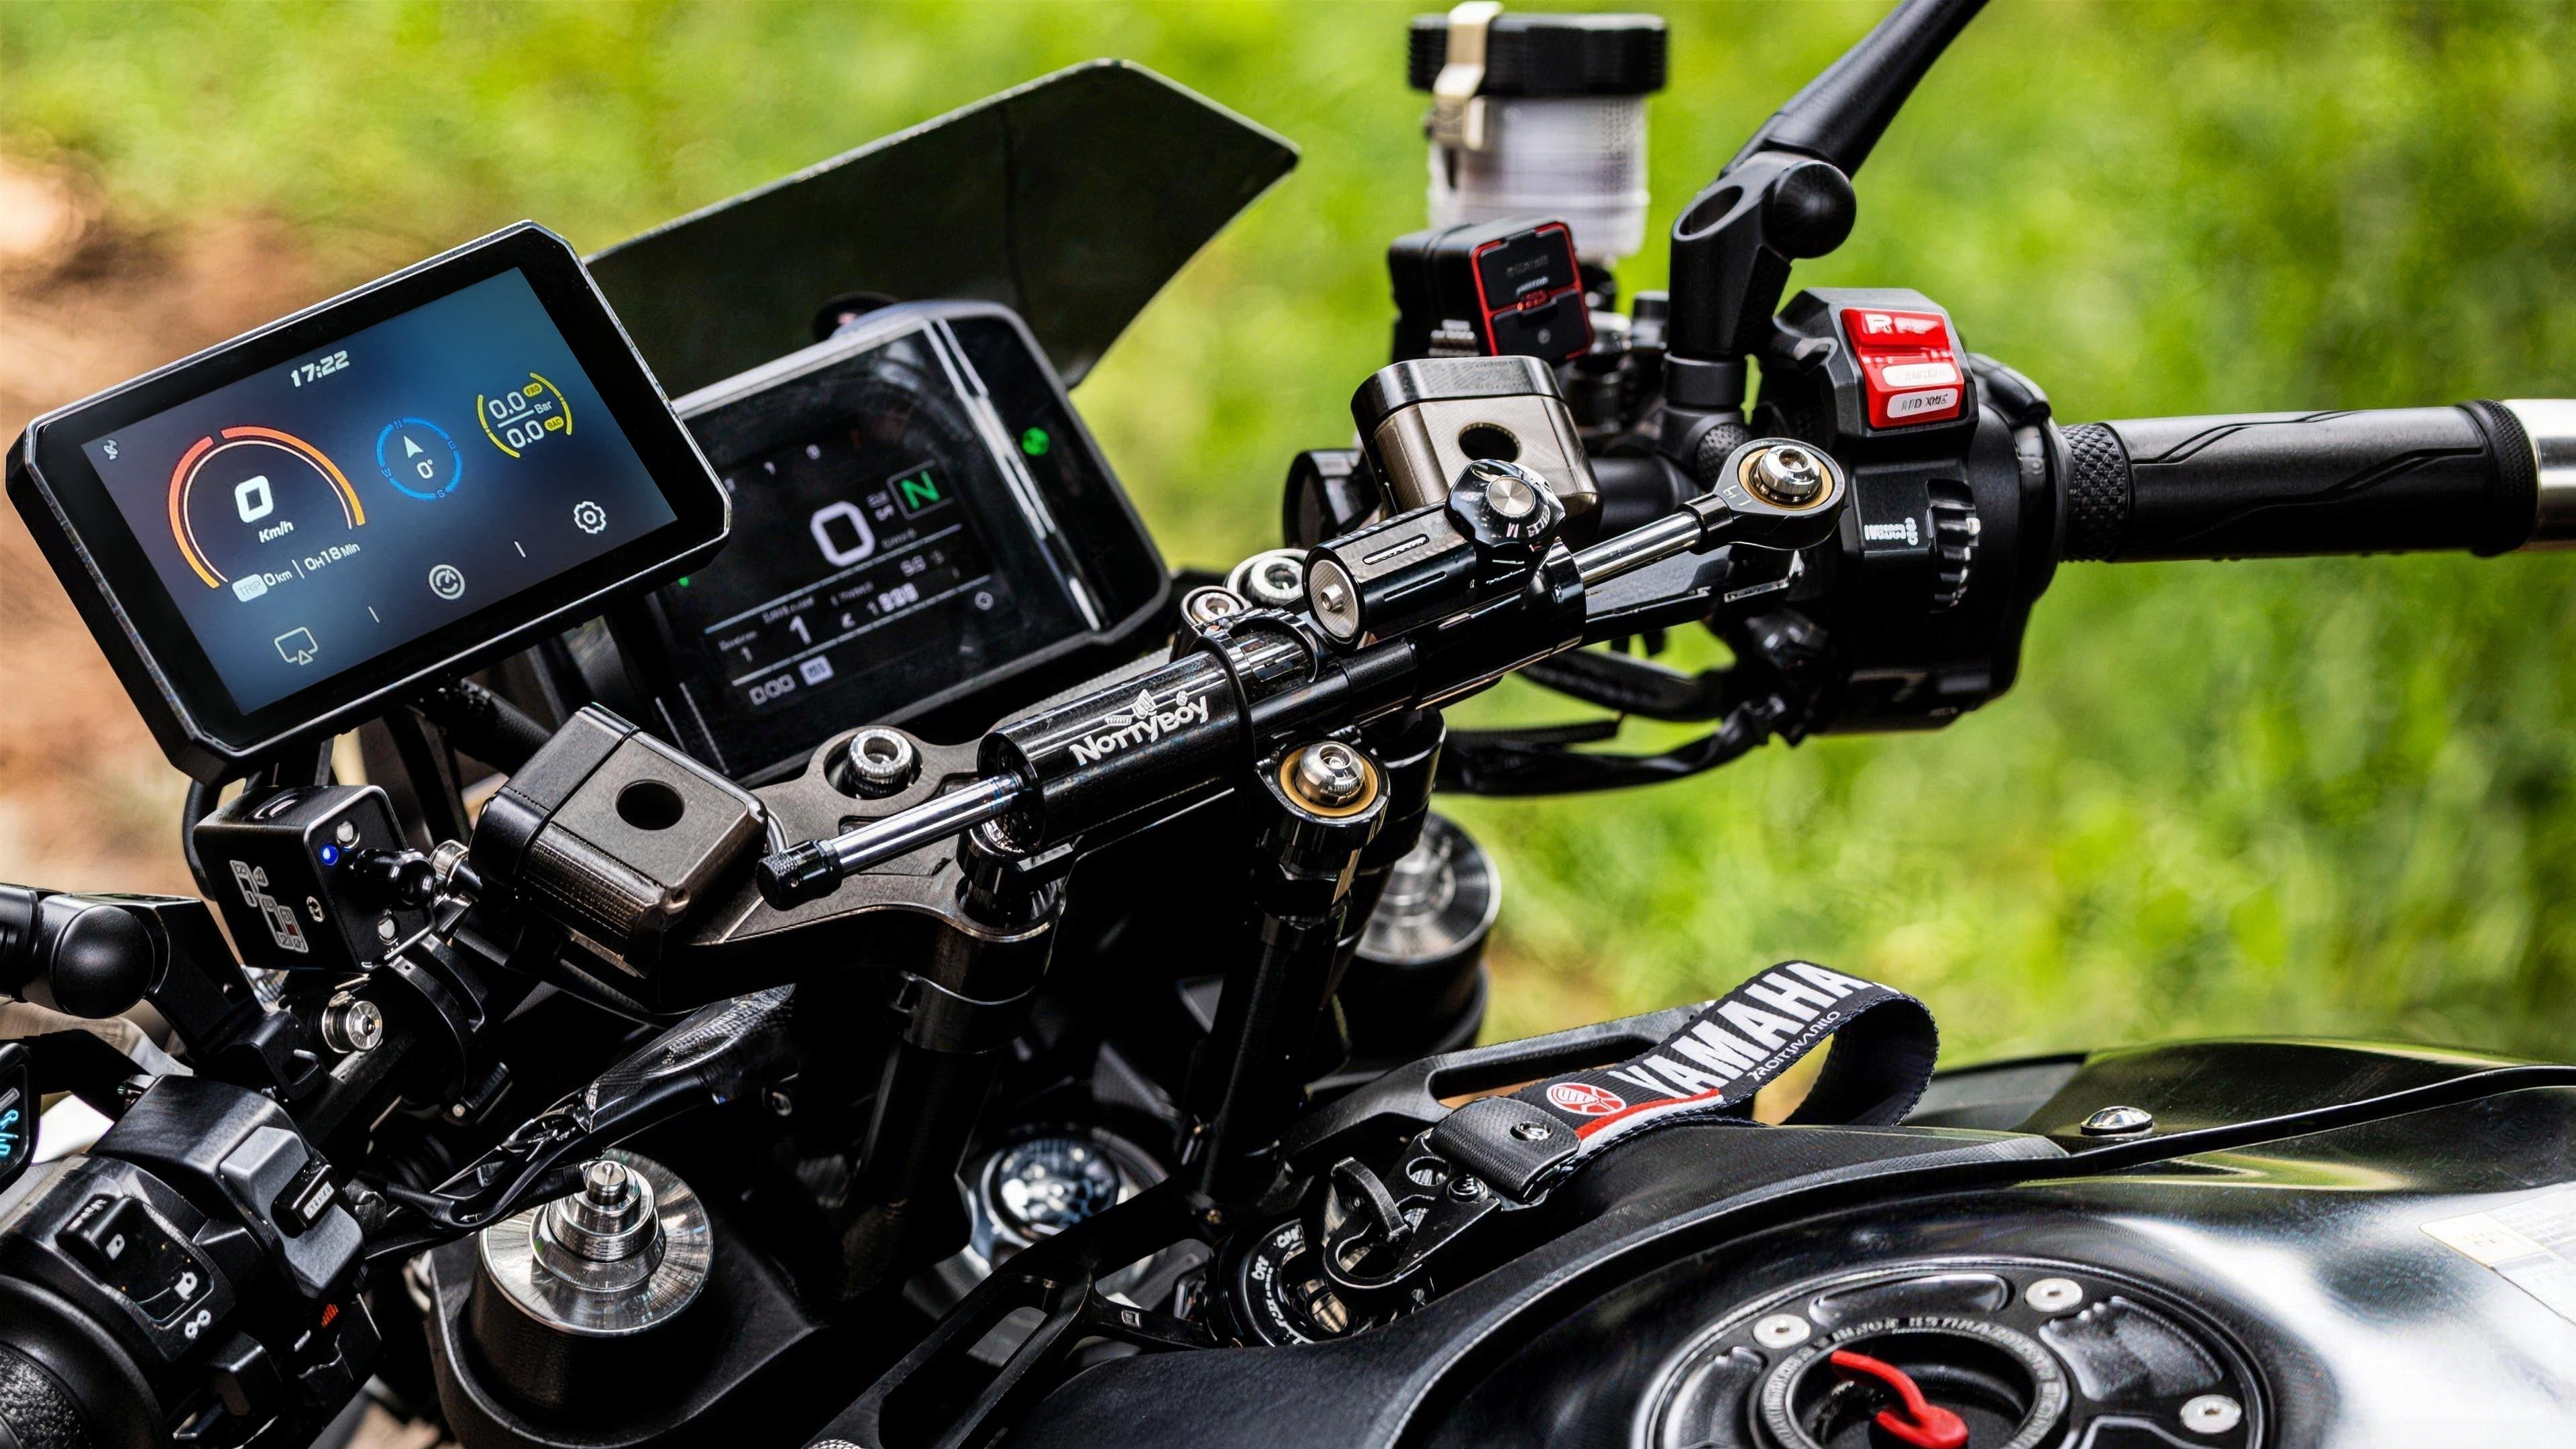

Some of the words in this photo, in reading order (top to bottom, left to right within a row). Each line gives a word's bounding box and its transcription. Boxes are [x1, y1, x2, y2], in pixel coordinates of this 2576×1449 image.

[290, 350, 350, 388] 17:22
[488, 391, 526, 419] 0.0
[534, 401, 552, 415] Bar
[393, 420, 403, 429] N
[506, 420, 545, 449] 0.0
[547, 419, 561, 429] BAC
[235, 475, 274, 523] 0
[437, 490, 445, 498] S
[900, 470, 941, 510] N
[258, 521, 294, 543] Km/h
[810, 500, 875, 567] 0
[237, 580, 262, 597] TRIP
[788, 615, 812, 645] 1
[1608, 962, 1876, 1099] YAMAHA
